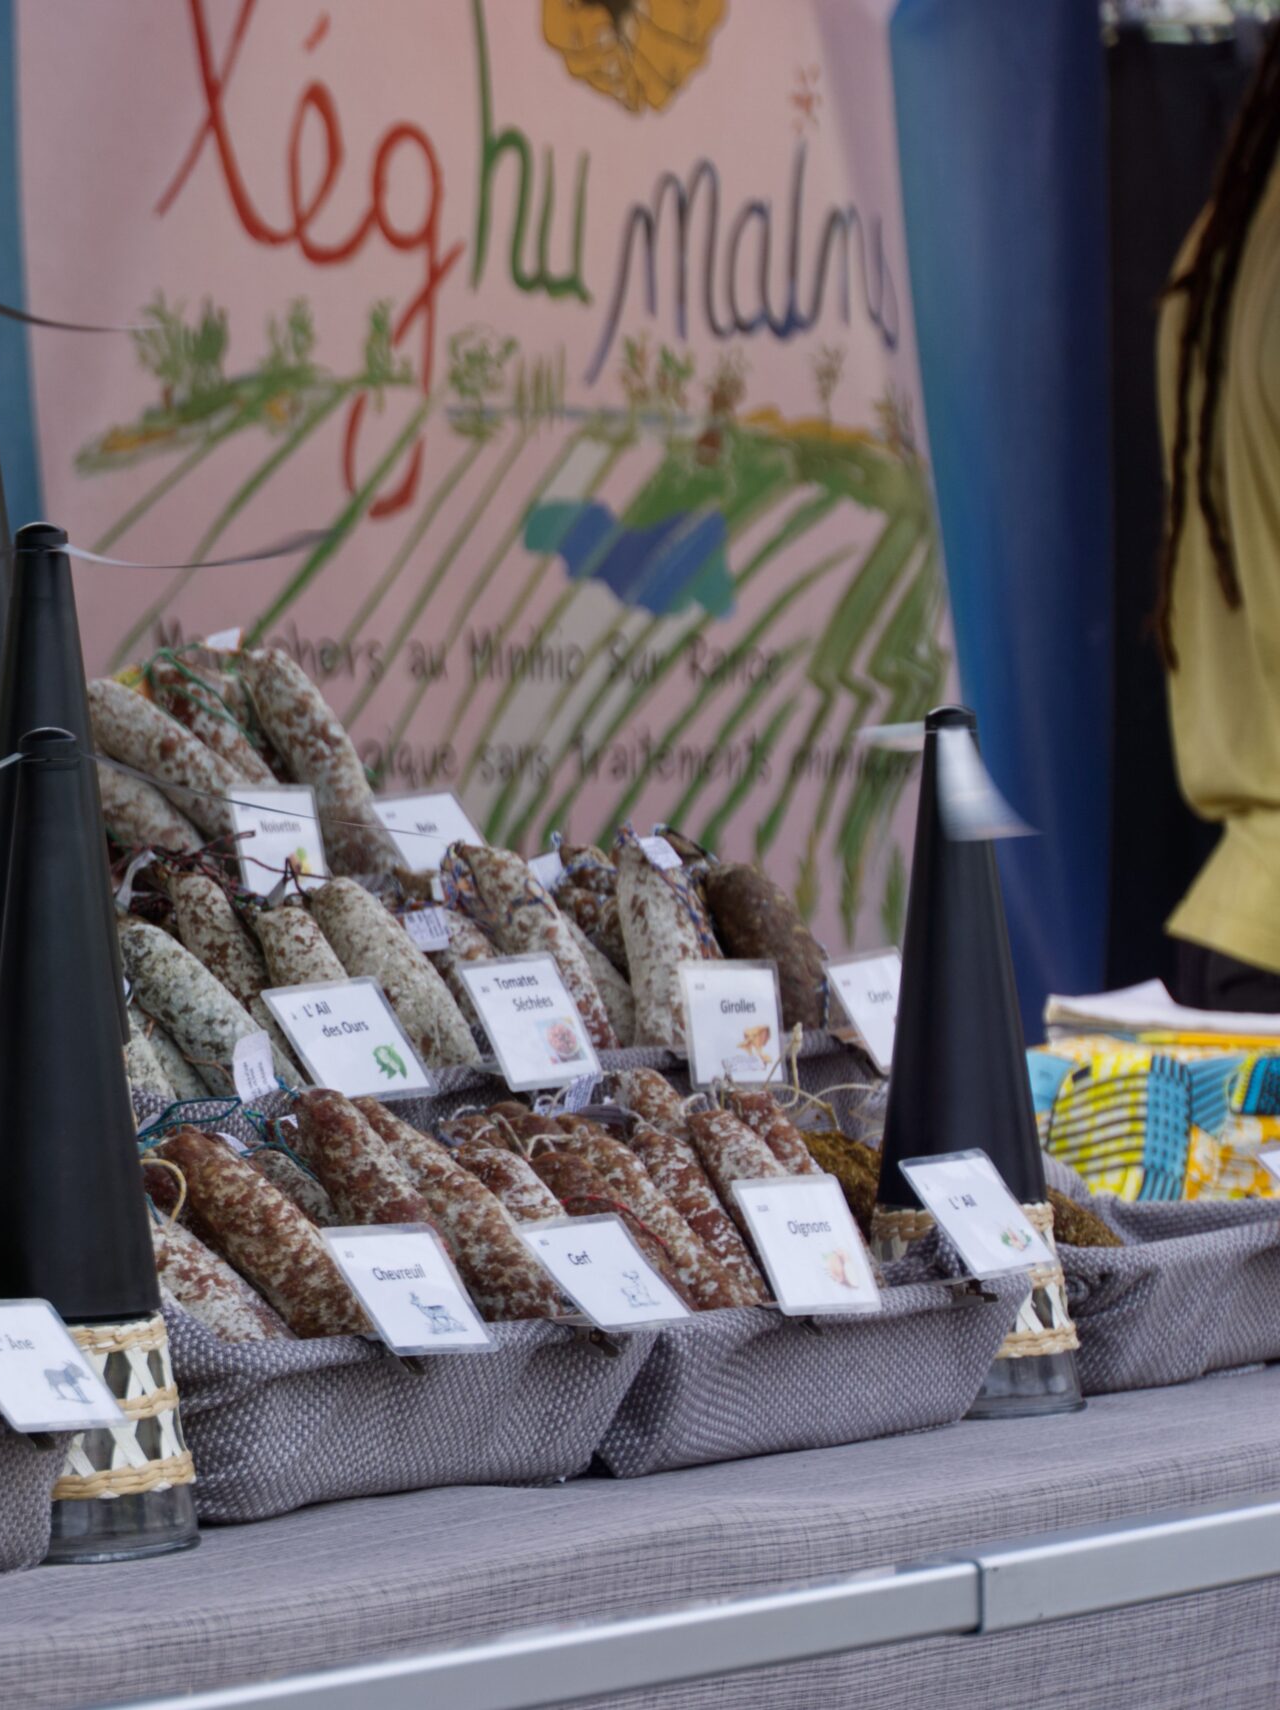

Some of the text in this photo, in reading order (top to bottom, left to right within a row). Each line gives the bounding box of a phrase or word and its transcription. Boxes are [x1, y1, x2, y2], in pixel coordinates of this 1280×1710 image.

[260, 819, 302, 834] Noisettes
[493, 974, 539, 992] Tomates
[720, 999, 757, 1015] Girolles
[322, 1020, 370, 1038] des Ours
[787, 1219, 833, 1238] Oignons
[567, 1250, 593, 1267] Cerf
[372, 1263, 428, 1282] Chevreuil
